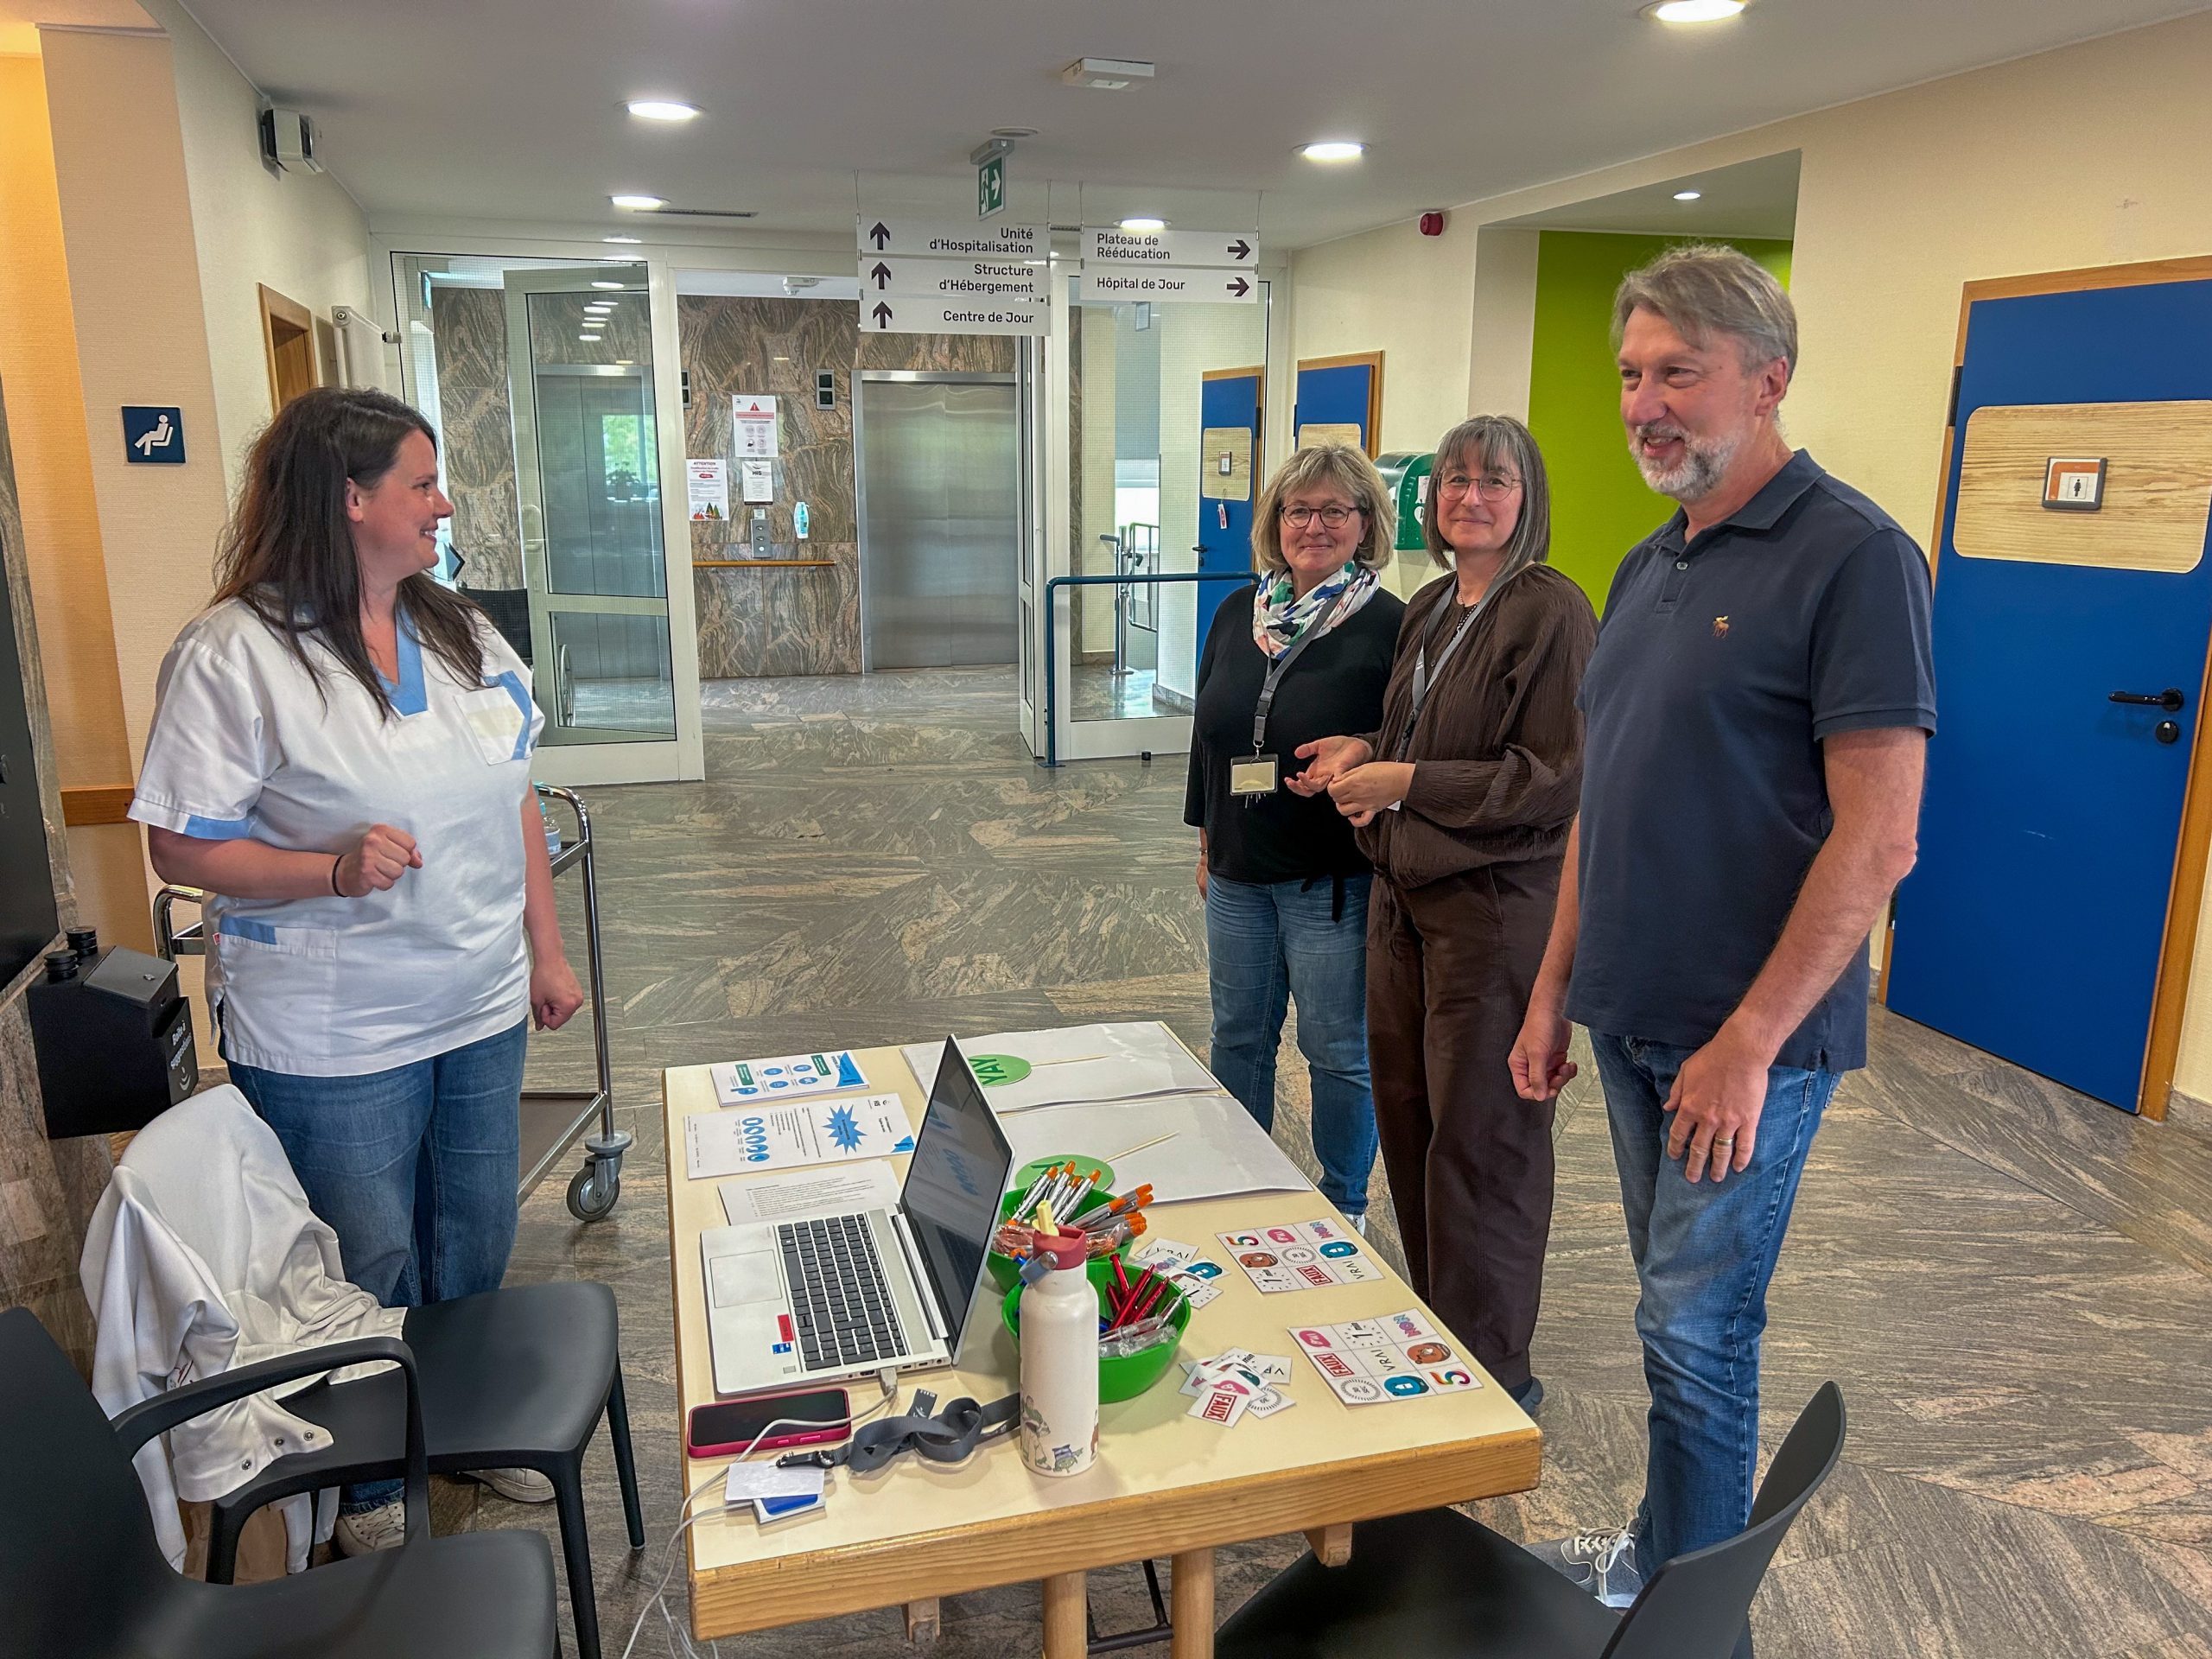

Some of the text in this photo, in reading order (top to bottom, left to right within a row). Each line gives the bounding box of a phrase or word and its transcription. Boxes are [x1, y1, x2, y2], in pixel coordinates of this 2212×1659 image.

[1001, 227, 1033, 239] Unité
[1096, 233, 1159, 246] Plateau de
[930, 238, 1033, 253] d'Hospitalisation
[1096, 246, 1170, 259] Rééducation
[974, 264, 1033, 276] Structure
[939, 279, 1033, 295] d'Hébergement
[1096, 277, 1185, 290] Hôpital de Jour
[943, 310, 1034, 324] Centre de Jour
[1309, 1221, 1335, 1239] NON
[1300, 1266, 1328, 1285] FAUX
[1342, 1261, 1364, 1279] VRAI
[1393, 1314, 1421, 1338] NON
[1319, 1354, 1351, 1376] FAUX
[1370, 1349, 1396, 1371] VRAI
[1207, 1394, 1233, 1420] FAUX
